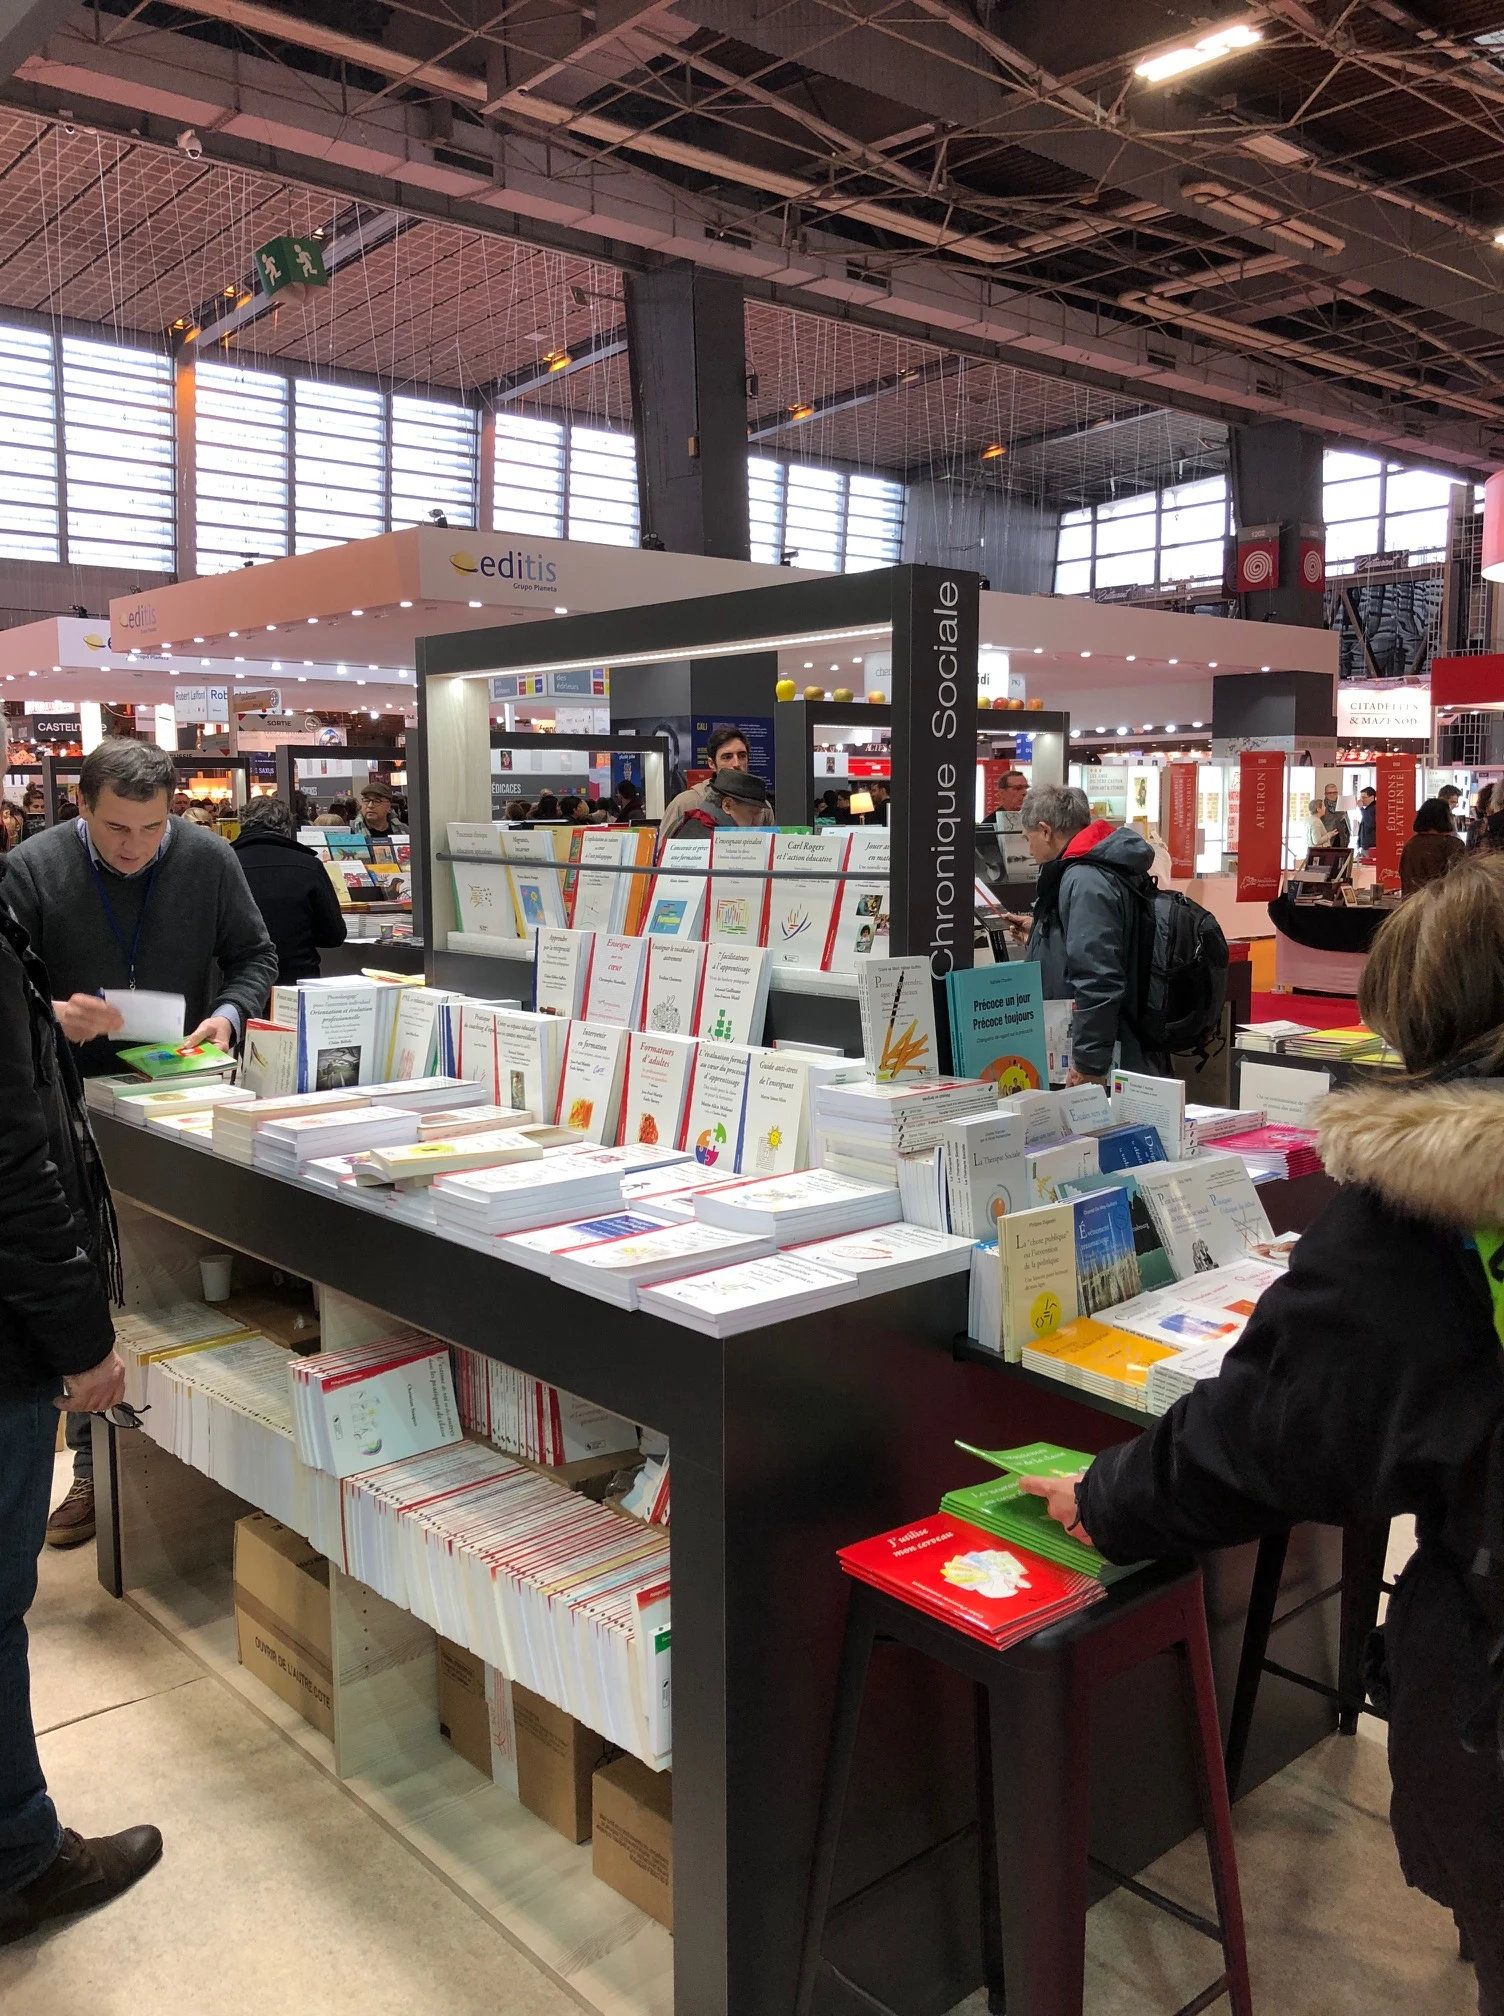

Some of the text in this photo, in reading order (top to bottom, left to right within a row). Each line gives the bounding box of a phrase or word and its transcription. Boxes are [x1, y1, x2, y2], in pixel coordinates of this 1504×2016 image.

[1251, 530, 1266, 538] 1202
[480, 551, 557, 582] editis
[513, 582, 557, 592] Grupo Planeta
[129, 604, 157, 628] editis
[932, 581, 958, 739] Sociale
[977, 673, 990, 685] idi
[176, 691, 205, 700] Robert Laffont
[211, 690, 228, 700] Rob
[1350, 702, 1418, 711] CITADELLES
[1361, 717, 1418, 725] MAZENOD
[491, 782, 522, 794] ÉDICACES
[1256, 772, 1266, 828] APEIRON
[1388, 774, 1396, 831] ÉDITIONS
[1396, 773, 1405, 836] L'ATTENTE
[715, 837, 762, 846] L'enseignant spécialisé
[788, 840, 825, 853] Carl Rogers
[865, 842, 883, 851] Jouer
[1396, 839, 1404, 856] DE
[783, 853, 805, 861] l'action
[805, 855, 833, 863] éducative
[930, 763, 961, 981] Chronique
[607, 939, 631, 951] Enseigne
[720, 952, 749, 961] facilitateurs
[716, 963, 751, 976] l'apprentissage
[974, 993, 1030, 1012] Précoce un jour
[973, 1010, 1034, 1030] Précoce toujours
[582, 1028, 606, 1039] Intervenir
[583, 1040, 607, 1051] formation
[640, 1042, 675, 1057] Formateurs
[642, 1054, 670, 1068] d'adultes
[699, 1049, 748, 1065] L'évaluation format
[719, 1064, 725, 1072] du
[725, 1067, 746, 1076] processu
[760, 1061, 798, 1074] Guide anti-stress
[704, 1072, 740, 1087] d'apprentissage
[759, 1076, 794, 1090] de l'enseignant
[973, 1150, 1020, 1166] La Thérapie Sociale
[1016, 1234, 1026, 1249] La
[1031, 1247, 1058, 1257] l'invention
[1024, 1258, 1059, 1270] de la politique
[887, 1528, 929, 1548] J'utilise
[892, 1531, 954, 1557] mon cerveau
[255, 1636, 331, 1710] OUVRIR DE L'AUTRE COTE
